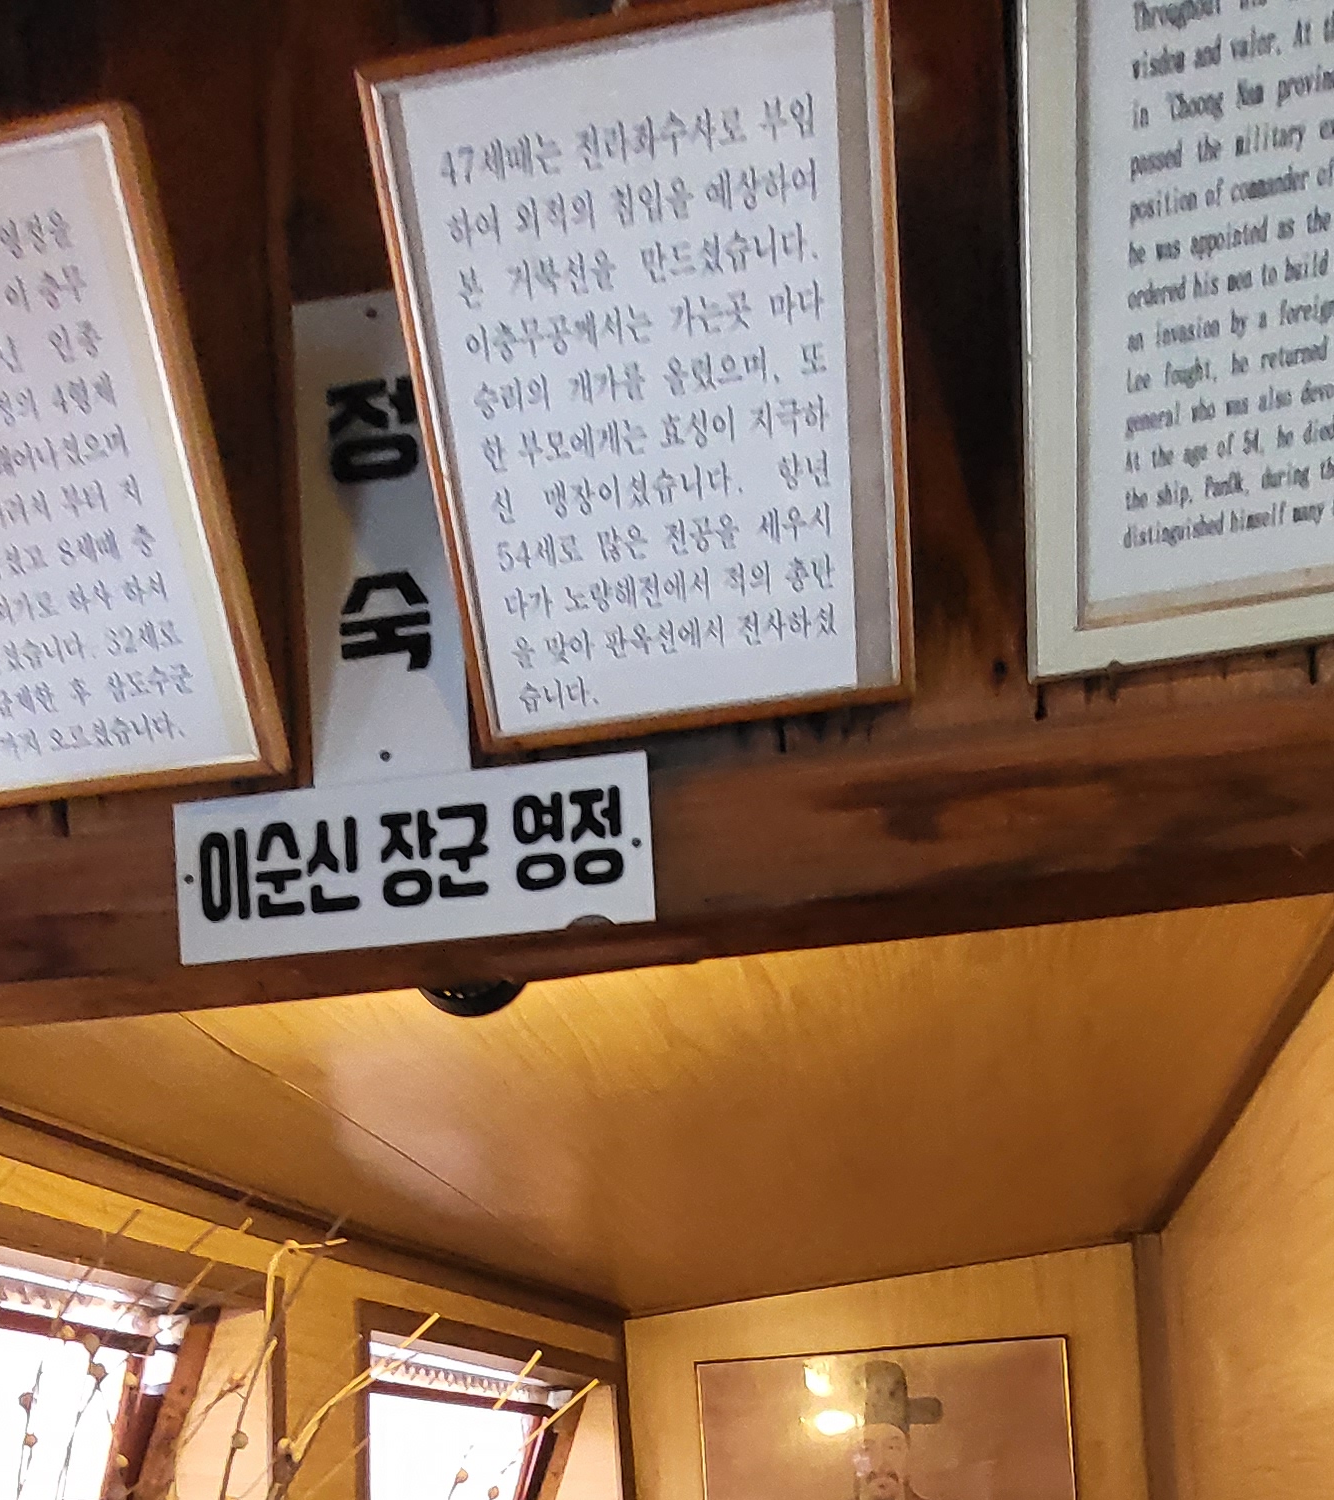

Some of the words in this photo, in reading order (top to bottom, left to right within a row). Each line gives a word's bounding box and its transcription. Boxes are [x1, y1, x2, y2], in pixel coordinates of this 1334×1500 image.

[1192, 33, 1222, 70] and
[1292, 17, 1311, 48] At
[1132, 99, 1149, 130] in
[1129, 137, 1182, 183] passed
[1196, 133, 1223, 164] the
[1234, 122, 1306, 158] military
[1128, 186, 1198, 228] position
[1204, 176, 1224, 208] of
[1229, 163, 1309, 204] commander
[1127, 239, 1146, 269] he
[1155, 238, 1180, 262] was
[1189, 214, 1268, 260] appointed
[1276, 217, 1295, 240] as
[1305, 204, 1331, 235] the
[1127, 273, 1187, 310] ordered
[1192, 270, 1219, 300] his
[1226, 269, 1253, 294] men
[1260, 262, 1277, 288] to
[1283, 247, 1329, 283] build
[1126, 331, 1144, 353] an
[1155, 315, 1220, 348] invasion
[1229, 307, 1248, 339] by
[1126, 367, 1151, 394] Lee
[1230, 349, 1249, 376] he
[1260, 334, 1329, 372] returned
[1124, 400, 1180, 439] general
[1190, 395, 1216, 423] who
[1224, 396, 1249, 417] was
[1257, 384, 1292, 413] also
[1124, 449, 1140, 473] At
[1151, 443, 1174, 469] the
[1182, 443, 1208, 468] age
[1216, 430, 1236, 459] of
[1276, 423, 1294, 449] he
[1124, 486, 1148, 511] the
[1260, 462, 1310, 490] during
[1122, 509, 1224, 549] distinguished
[1229, 500, 1286, 533] himself
[1291, 501, 1325, 526] many
[198, 813, 361, 924] 이순신
[379, 801, 491, 909] 장군
[512, 783, 626, 891] 영정
